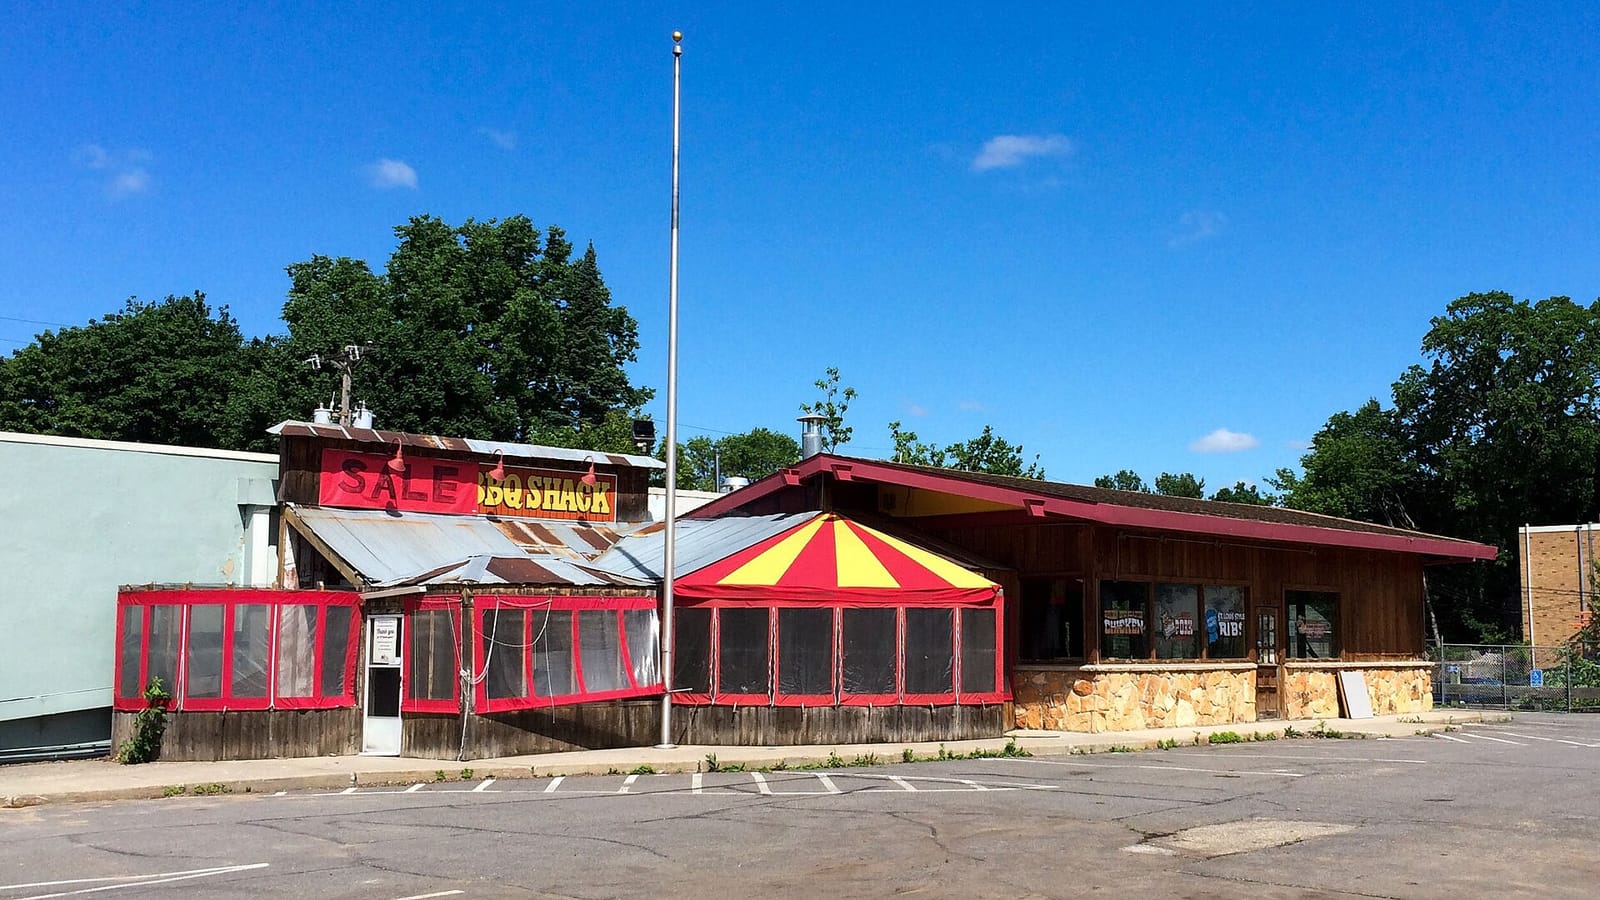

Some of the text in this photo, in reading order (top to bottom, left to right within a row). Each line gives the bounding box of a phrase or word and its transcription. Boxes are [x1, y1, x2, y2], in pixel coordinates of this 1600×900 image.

[338, 458, 459, 504] SALE
[526, 475, 610, 513] SHACK
[1104, 617, 1144, 635] CHICKEN
[1218, 621, 1243, 636] RIBS
